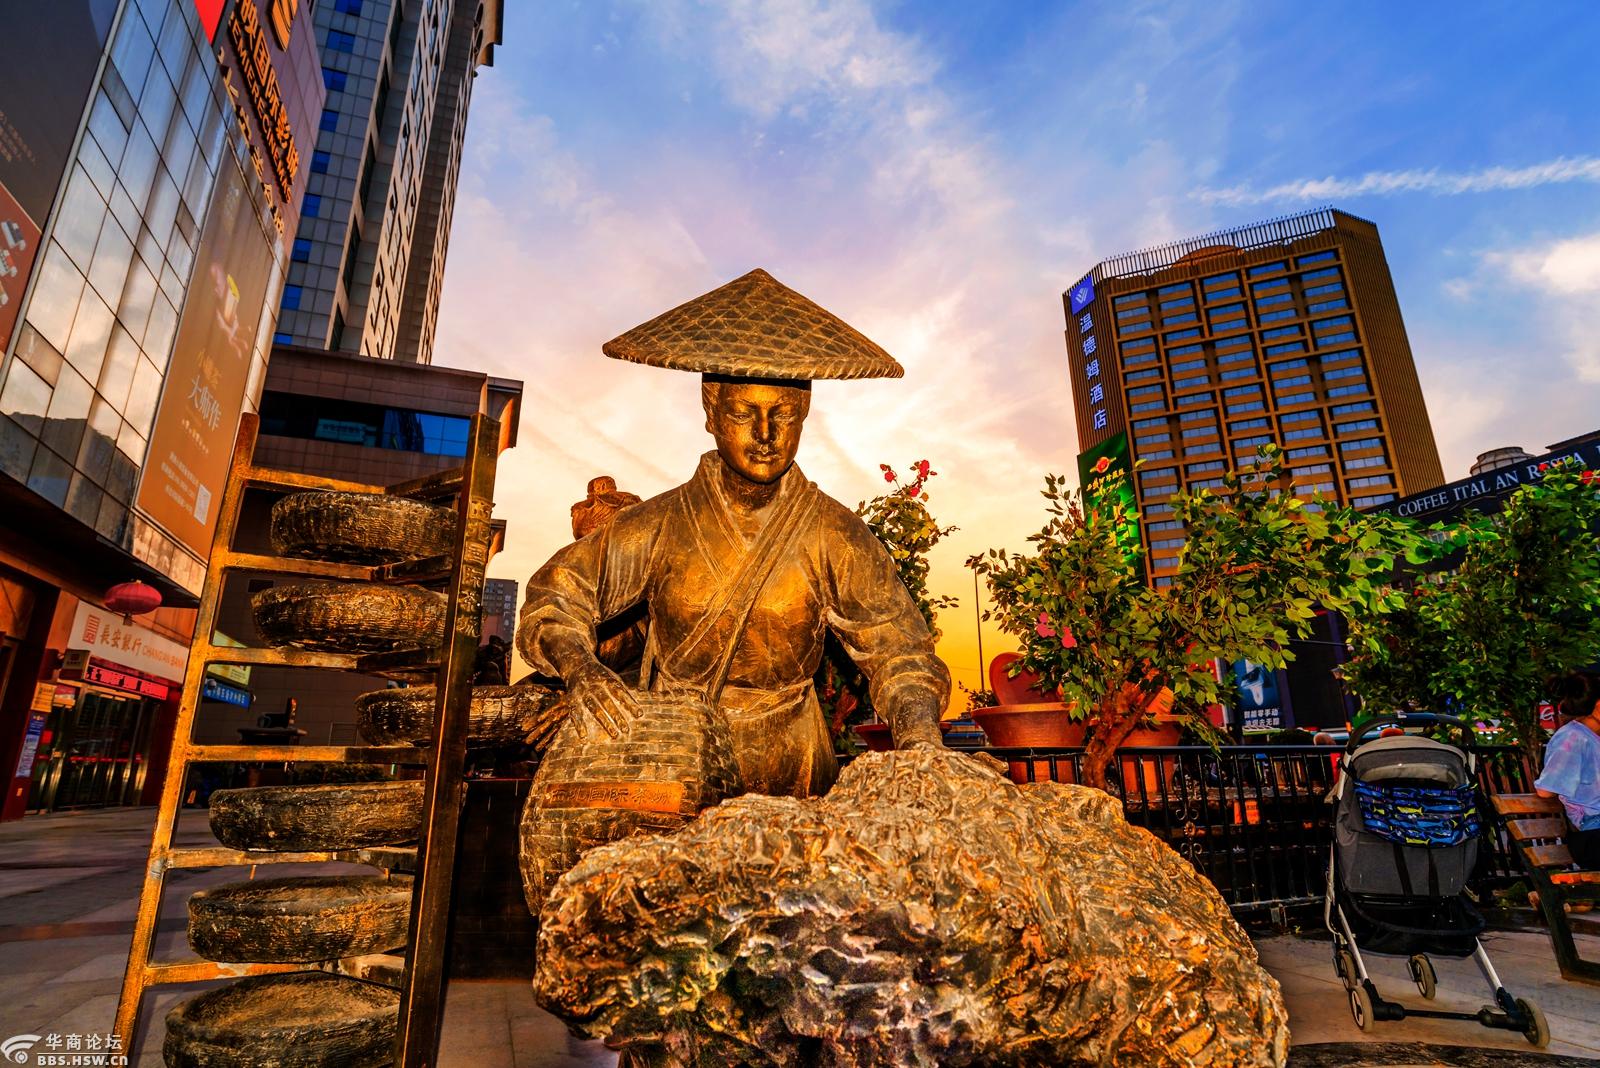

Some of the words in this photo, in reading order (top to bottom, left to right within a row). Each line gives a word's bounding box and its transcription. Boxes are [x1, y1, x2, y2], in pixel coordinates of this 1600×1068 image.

[1080, 312, 1107, 430] 温德姆酒店
[1398, 491, 1449, 517] COFFEE
[1453, 480, 1491, 501] ITAL
